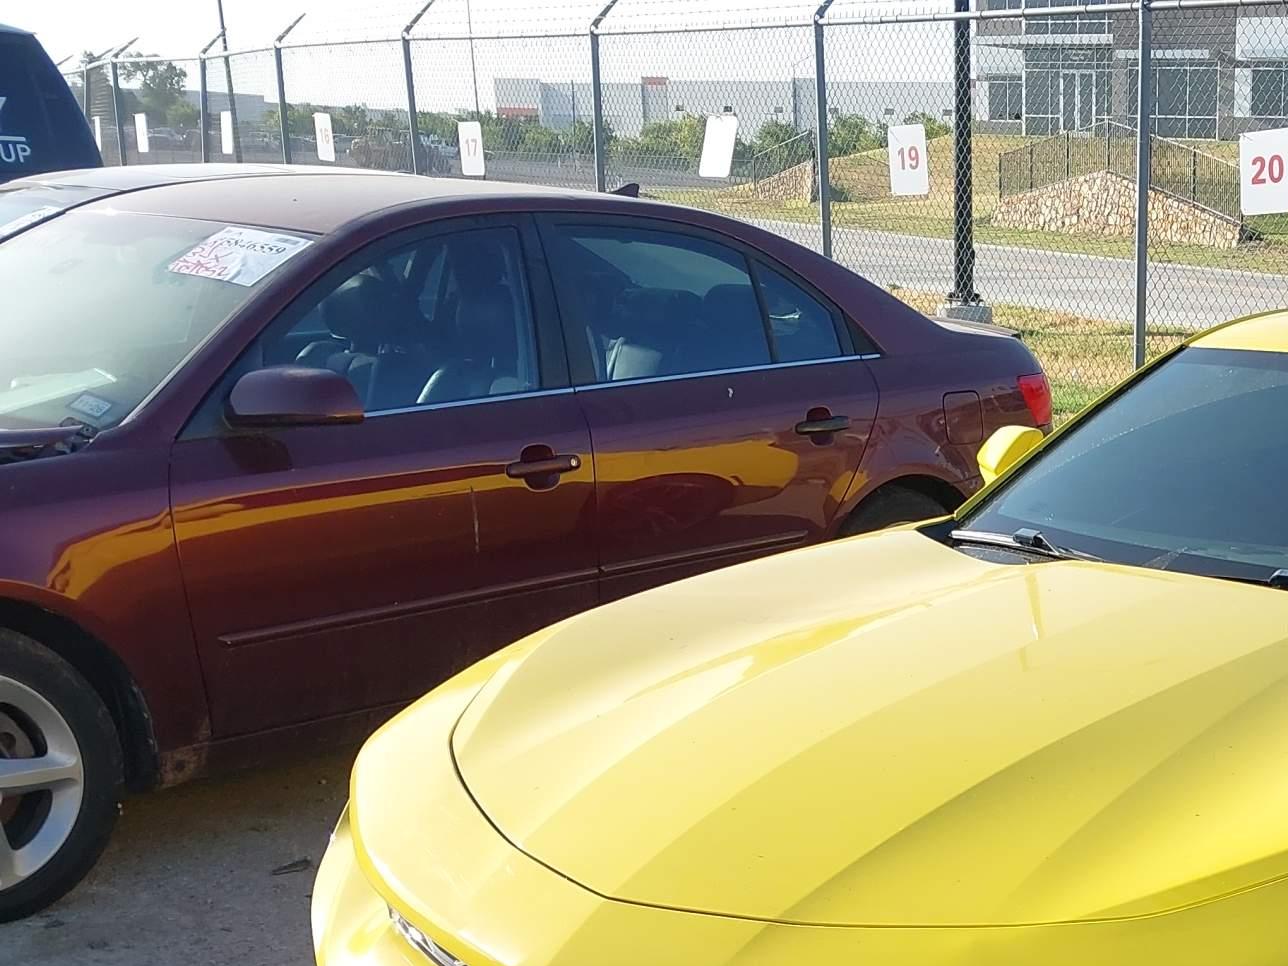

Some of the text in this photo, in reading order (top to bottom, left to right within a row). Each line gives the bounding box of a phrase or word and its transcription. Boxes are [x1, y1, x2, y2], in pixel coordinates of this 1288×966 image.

[464, 138, 479, 157] 17
[897, 145, 920, 171] 19
[1250, 155, 1285, 185] 20
